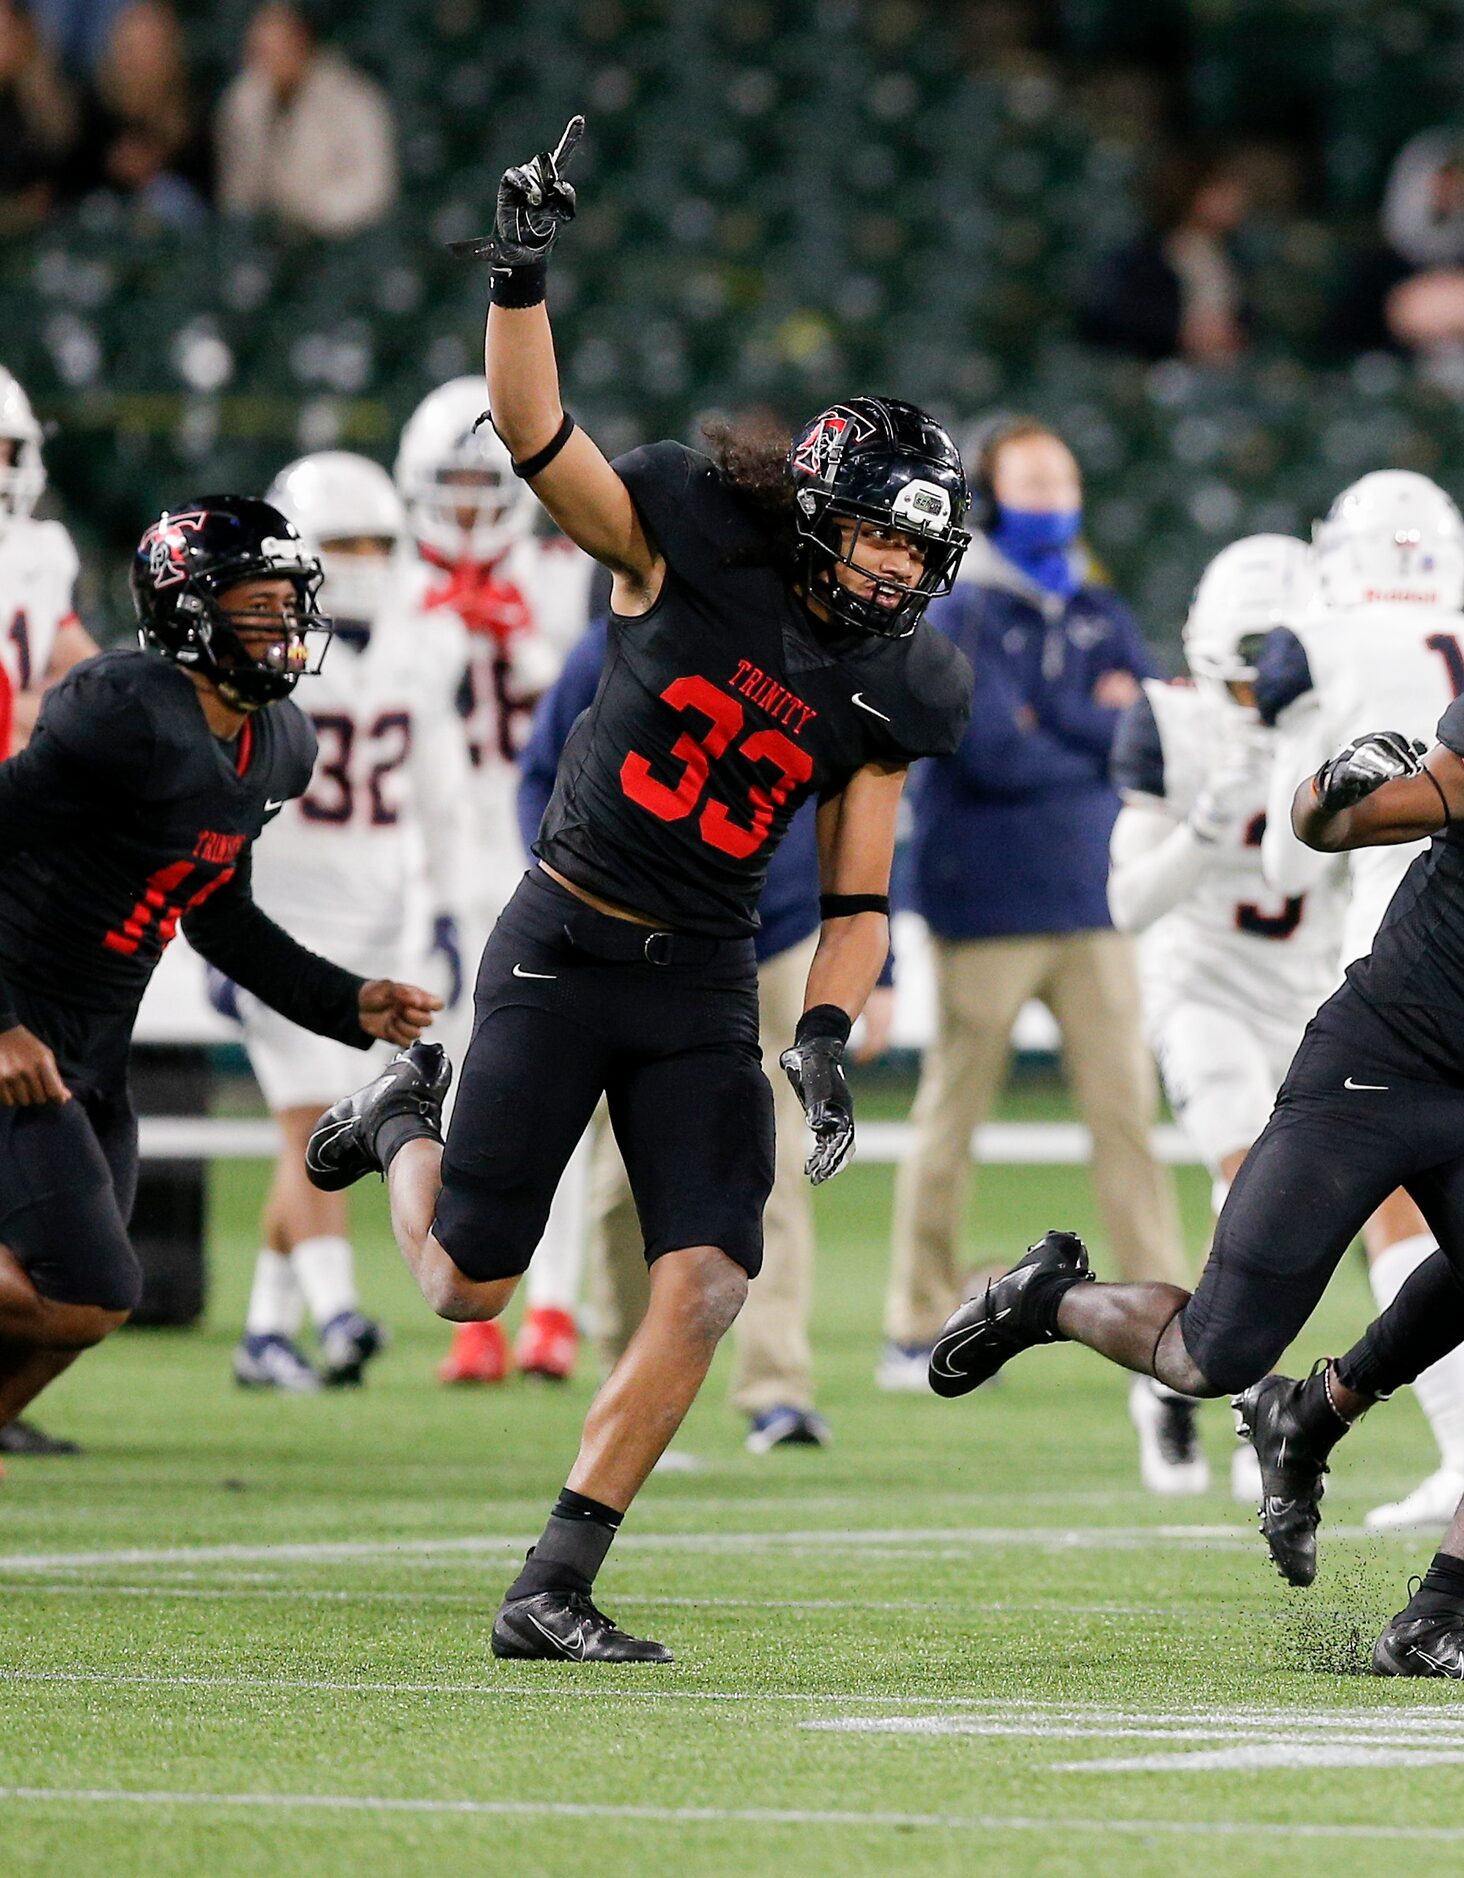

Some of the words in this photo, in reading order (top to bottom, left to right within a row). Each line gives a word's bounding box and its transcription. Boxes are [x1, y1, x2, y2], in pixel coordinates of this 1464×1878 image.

[727, 659, 818, 735] TRINITY
[299, 709, 412, 827] 32
[620, 675, 813, 859] 33
